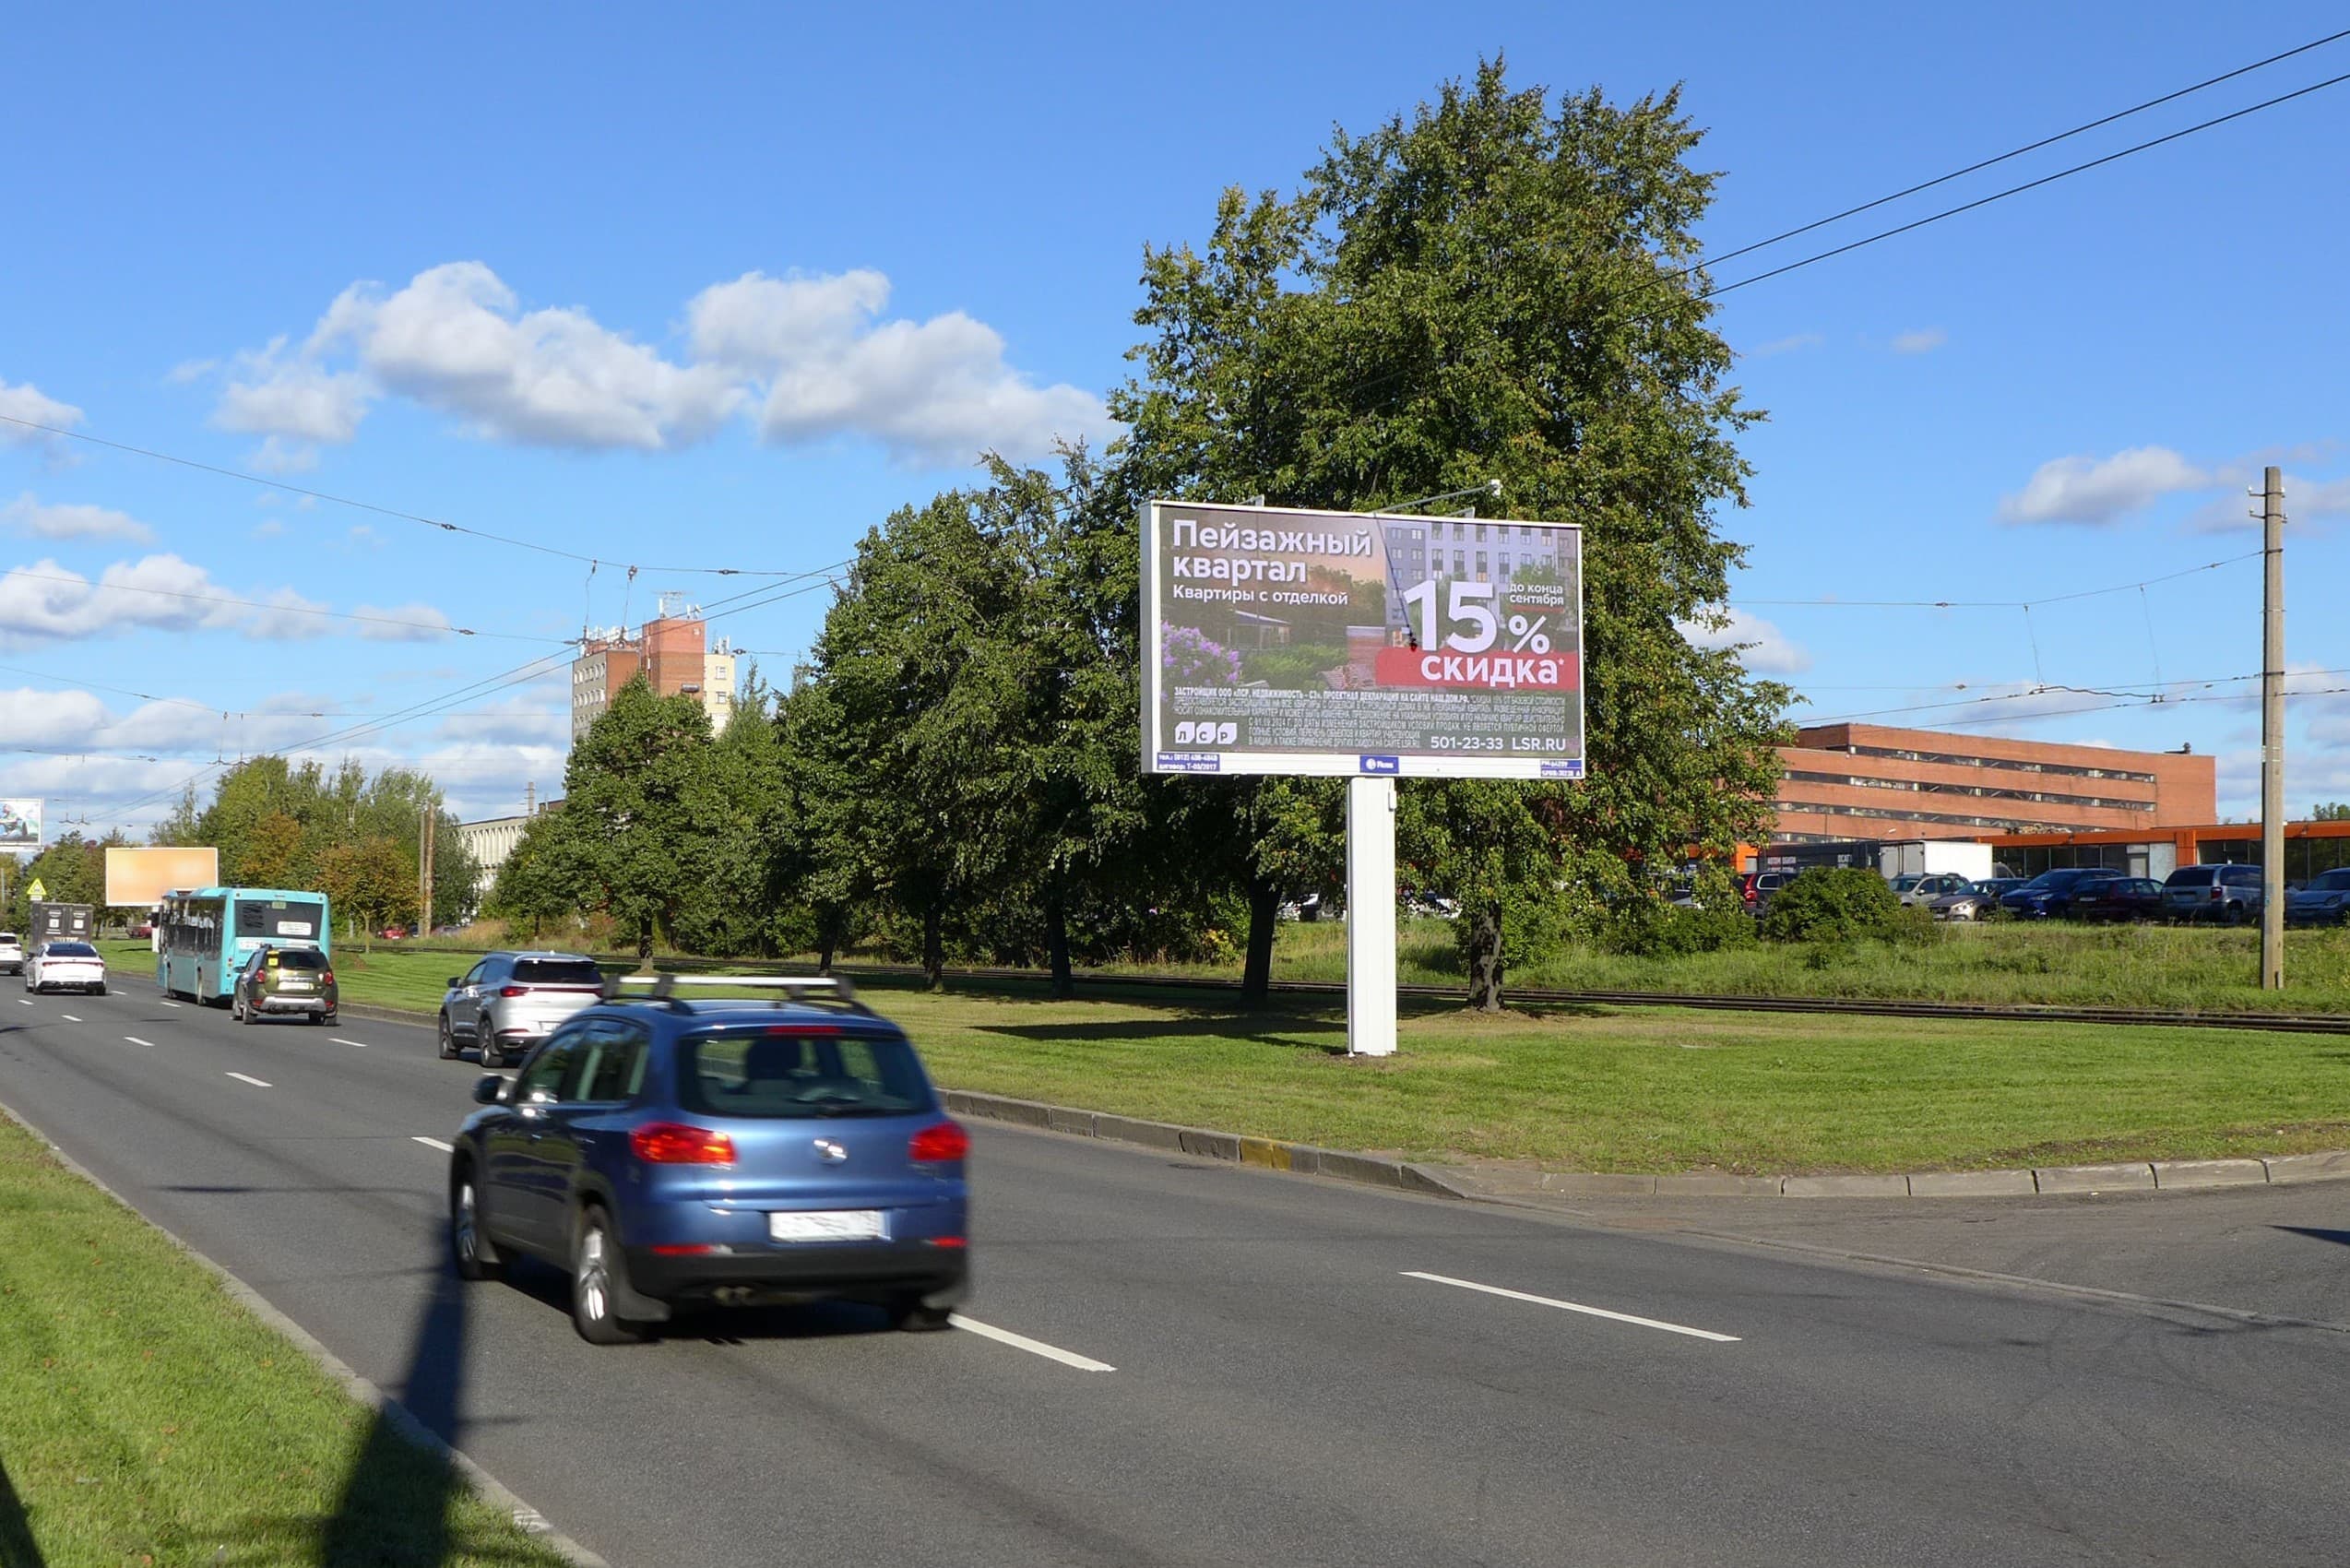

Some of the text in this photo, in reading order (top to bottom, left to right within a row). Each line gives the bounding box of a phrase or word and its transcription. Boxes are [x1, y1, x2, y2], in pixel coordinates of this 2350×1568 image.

[1173, 519, 1371, 555] Пейзажный
[1173, 556, 1306, 586] квартал
[1173, 585, 1348, 605] Квартиры с отделкой
[1510, 584, 1563, 596] до конца
[1510, 594, 1564, 606] сентября
[1430, 736, 1566, 751] 501-23-33 LSR.RU
